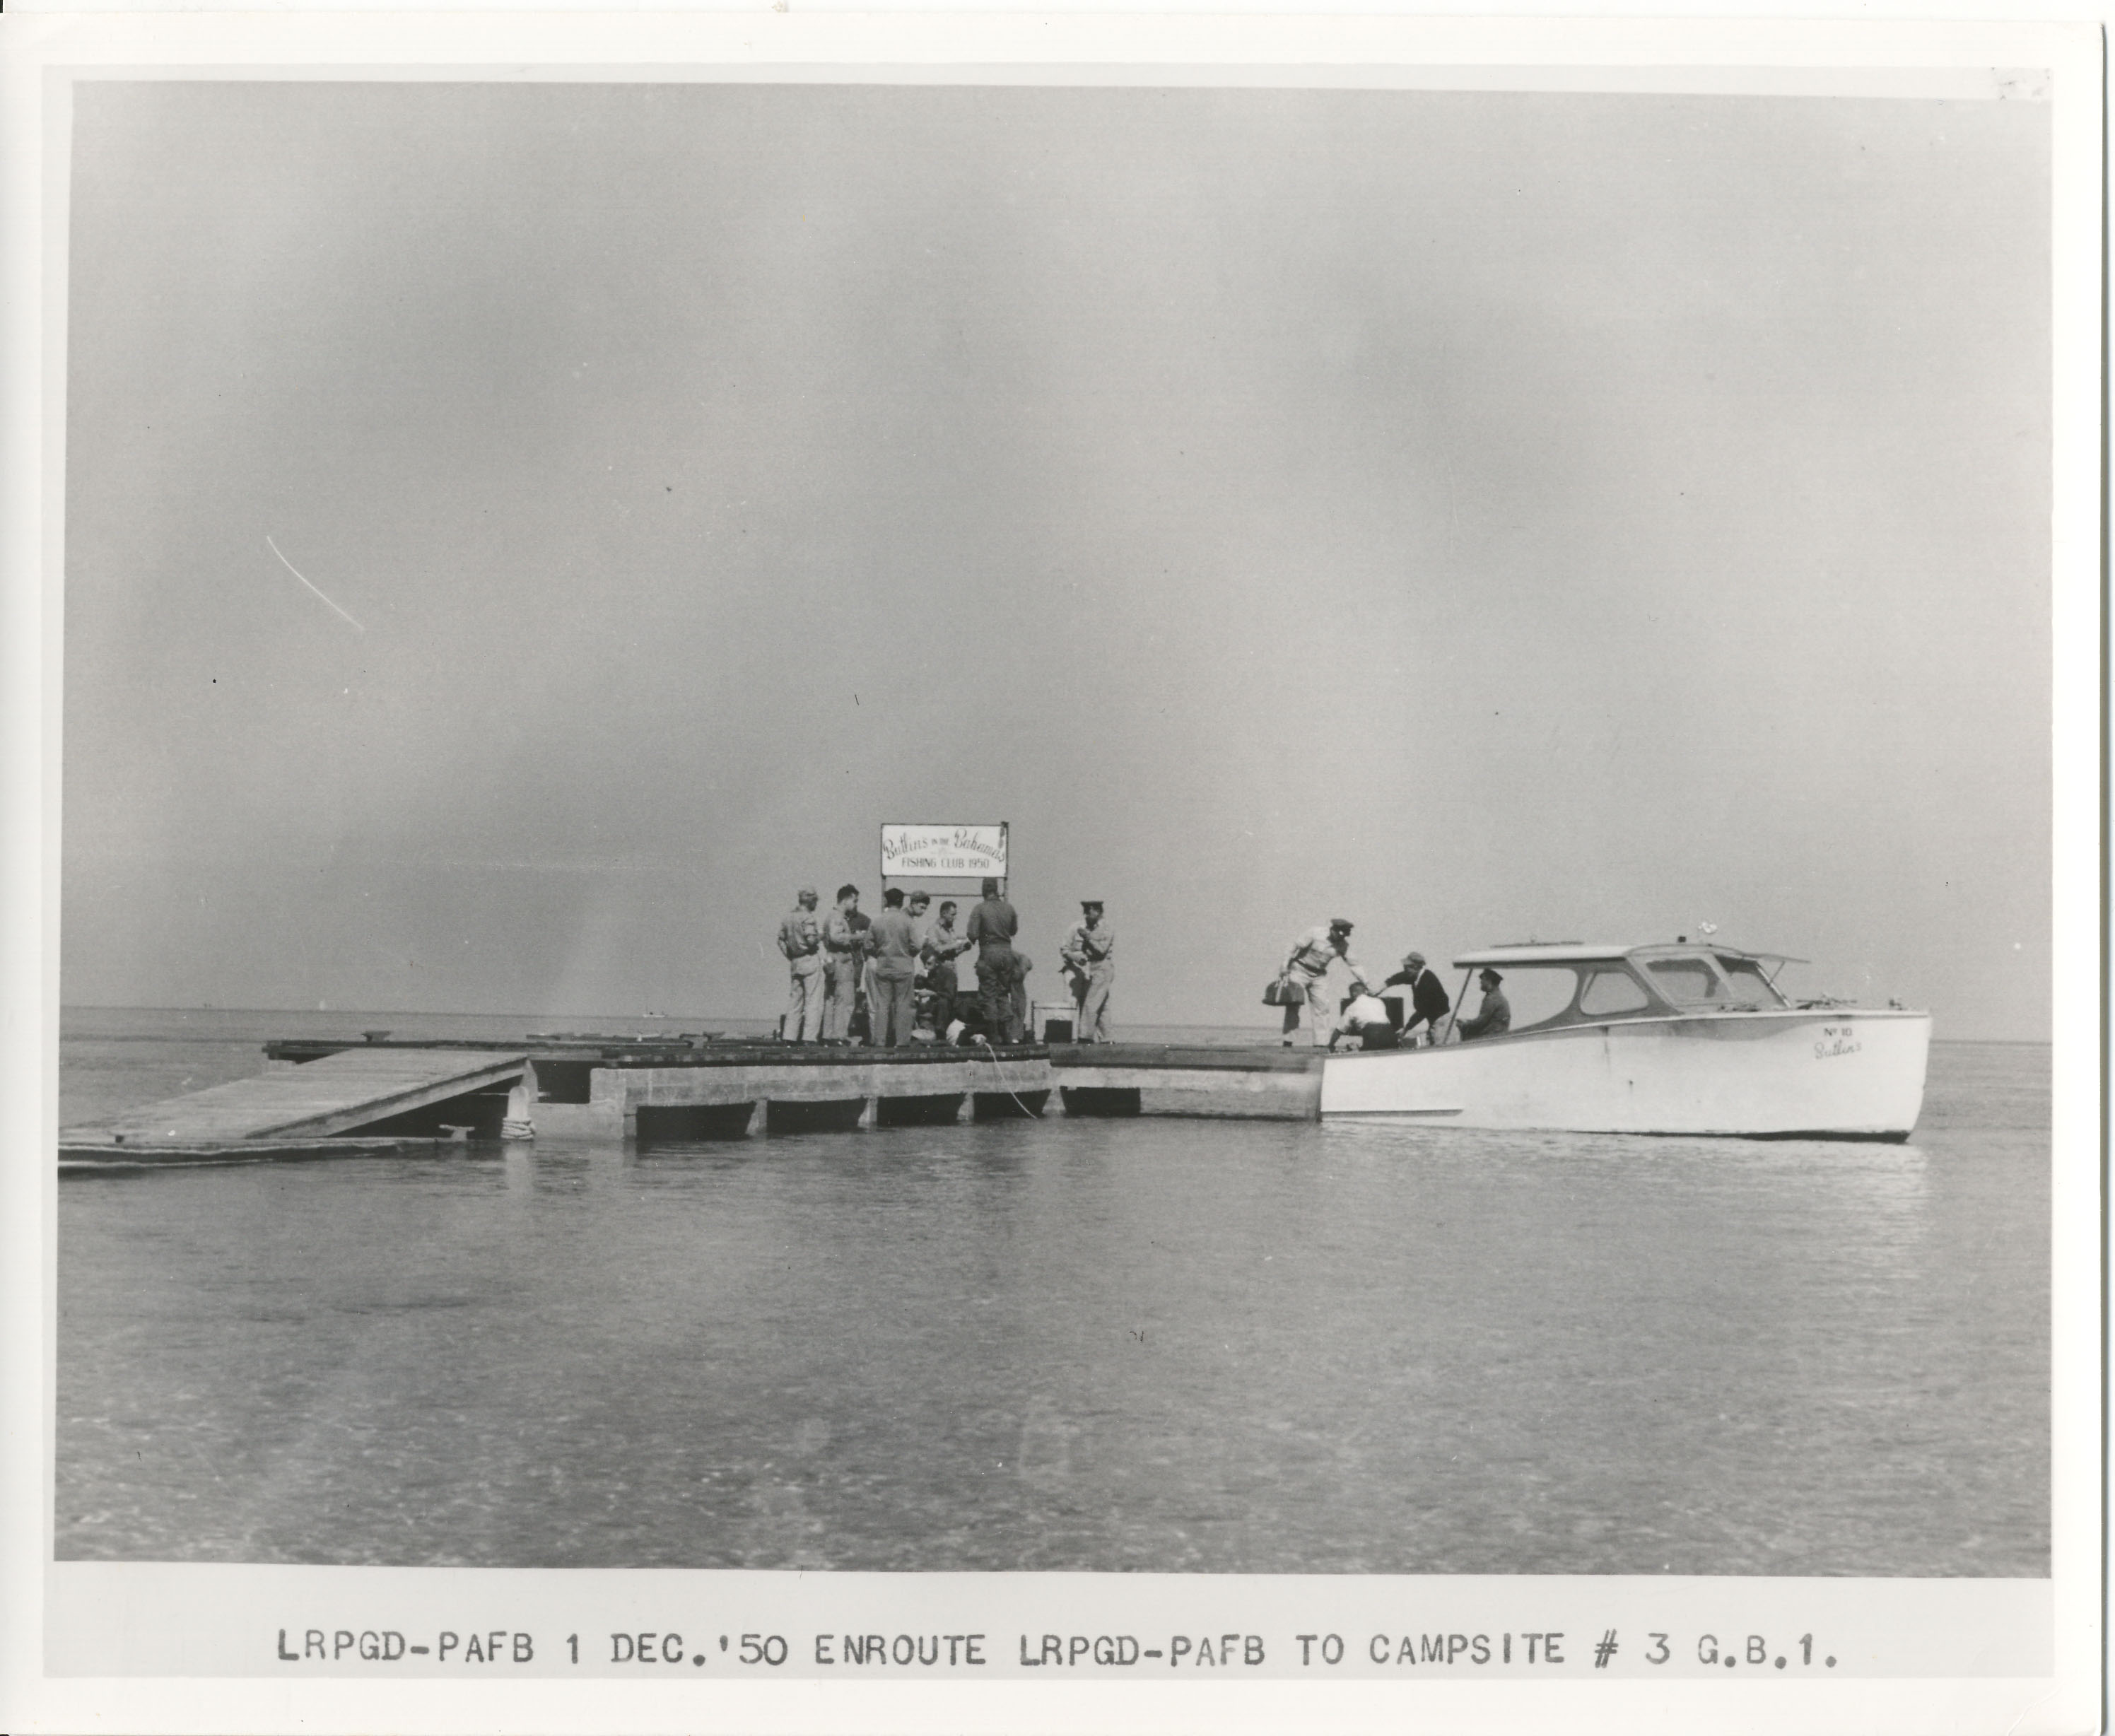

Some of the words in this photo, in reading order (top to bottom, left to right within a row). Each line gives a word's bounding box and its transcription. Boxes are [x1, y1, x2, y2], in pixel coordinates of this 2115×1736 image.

[954, 828, 1004, 862] Bahamas
[902, 857, 937, 868] FISHING
[941, 857, 964, 869] CLUB
[968, 858, 990, 869] 1950
[1841, 1028, 1853, 1037] 10
